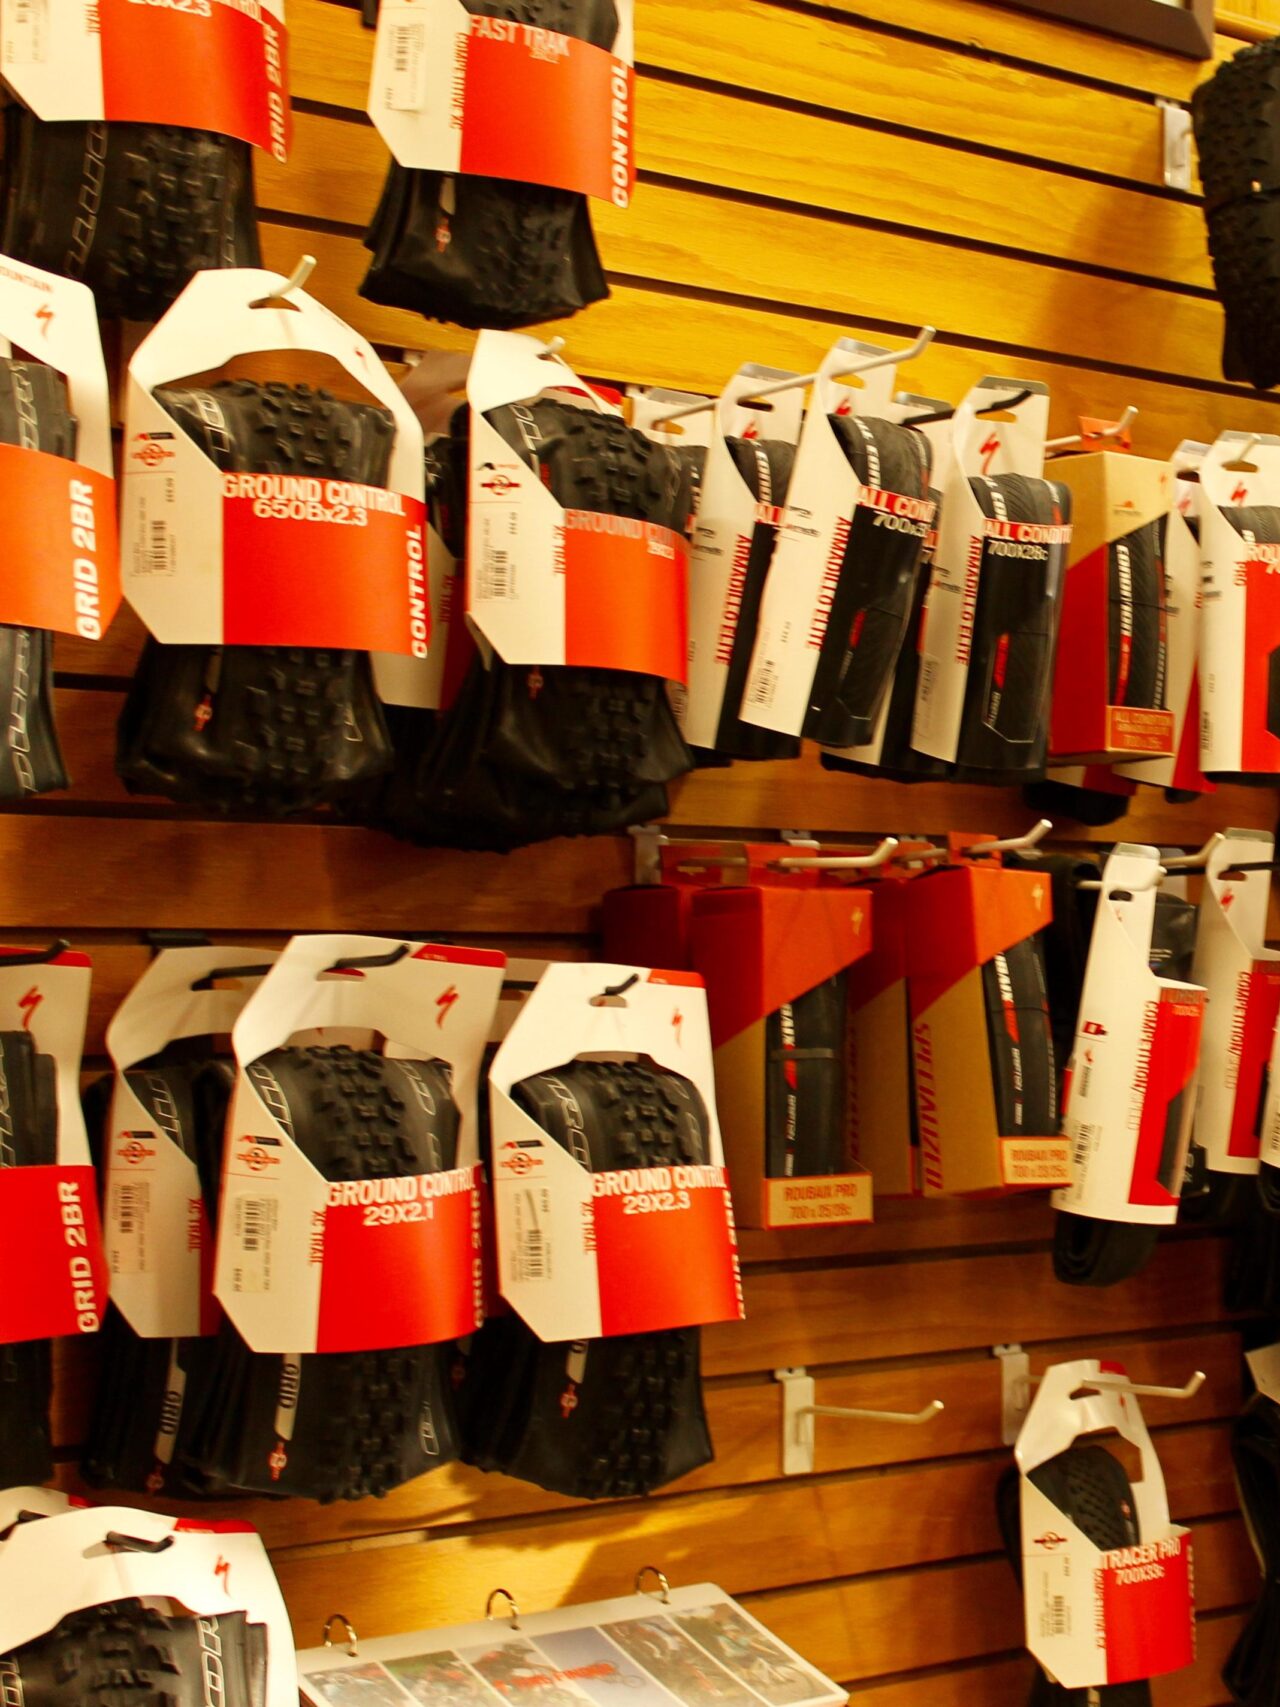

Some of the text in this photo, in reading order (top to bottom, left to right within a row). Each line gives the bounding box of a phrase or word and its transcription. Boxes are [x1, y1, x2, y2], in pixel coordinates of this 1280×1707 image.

[470, 17, 519, 43] FAST
[523, 25, 570, 57] TRAK
[268, 91, 287, 163] GRID
[611, 62, 629, 208] CONTROL
[222, 474, 407, 517] GROUND CONTROL
[253, 499, 369, 527] 650Bx2.3
[857, 485, 891, 513] ALL
[983, 516, 1016, 541] ALL
[69, 478, 101, 641] GRID 2BR
[406, 525, 428, 660] CONTROL
[713, 534, 753, 666] ARMADILLO ELITE
[805, 516, 853, 650] ARMADILLO ELITE
[955, 535, 984, 666] ARMADILLO ELITE
[914, 1023, 944, 1190] SPECIALIZED
[324, 1170, 475, 1207] GROUND CONTROL
[592, 1165, 727, 1198] GROUND CONTROL
[362, 1202, 436, 1228] 29X2.1
[623, 1191, 691, 1216] 29X2.3
[58, 1181, 100, 1333] GRID 2BR
[309, 1232, 325, 1267] TRAIL
[583, 1222, 597, 1254] TRAIL
[1102, 1536, 1182, 1570] TRACER PRO
